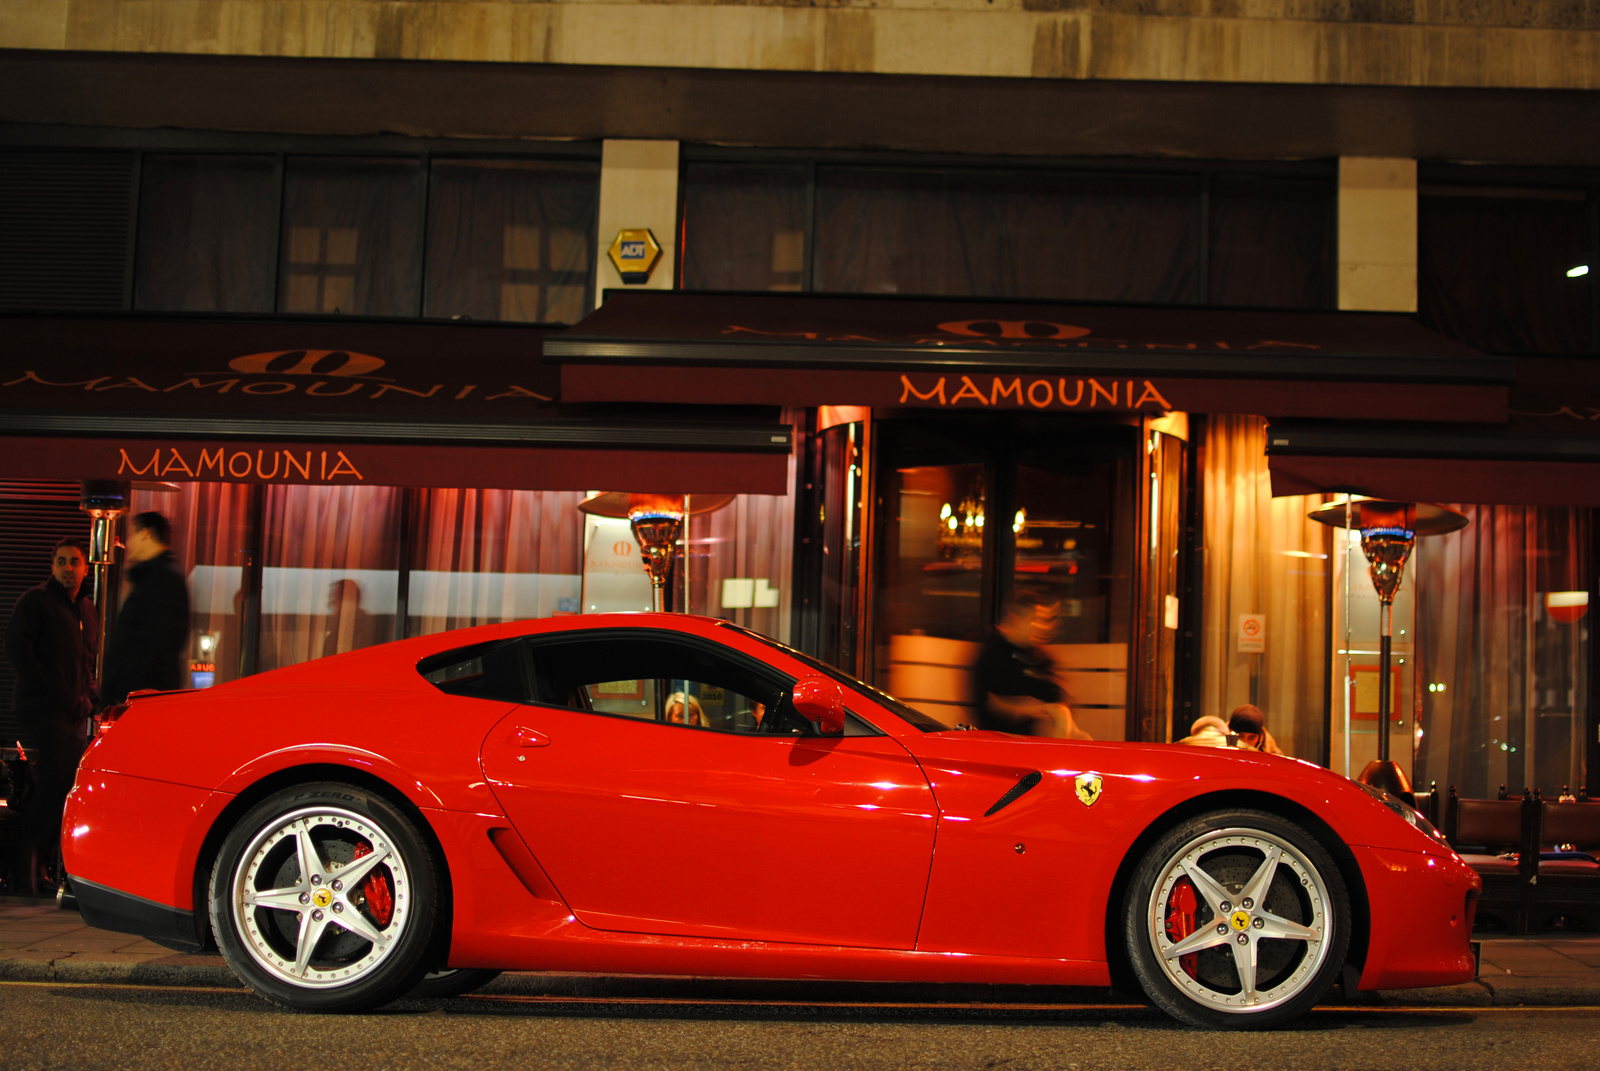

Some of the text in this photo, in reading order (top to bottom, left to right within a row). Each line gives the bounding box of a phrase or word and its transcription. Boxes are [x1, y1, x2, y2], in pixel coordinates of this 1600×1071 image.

[621, 244, 645, 257] ADT
[2, 371, 552, 400] MAMOUNIA
[900, 375, 1172, 409] MAMOUNIA
[117, 448, 364, 480] MAMOUNIA
[701, 693, 723, 701] 2010
[308, 791, 355, 801] ZERO
[1529, 875, 1538, 885] 4
